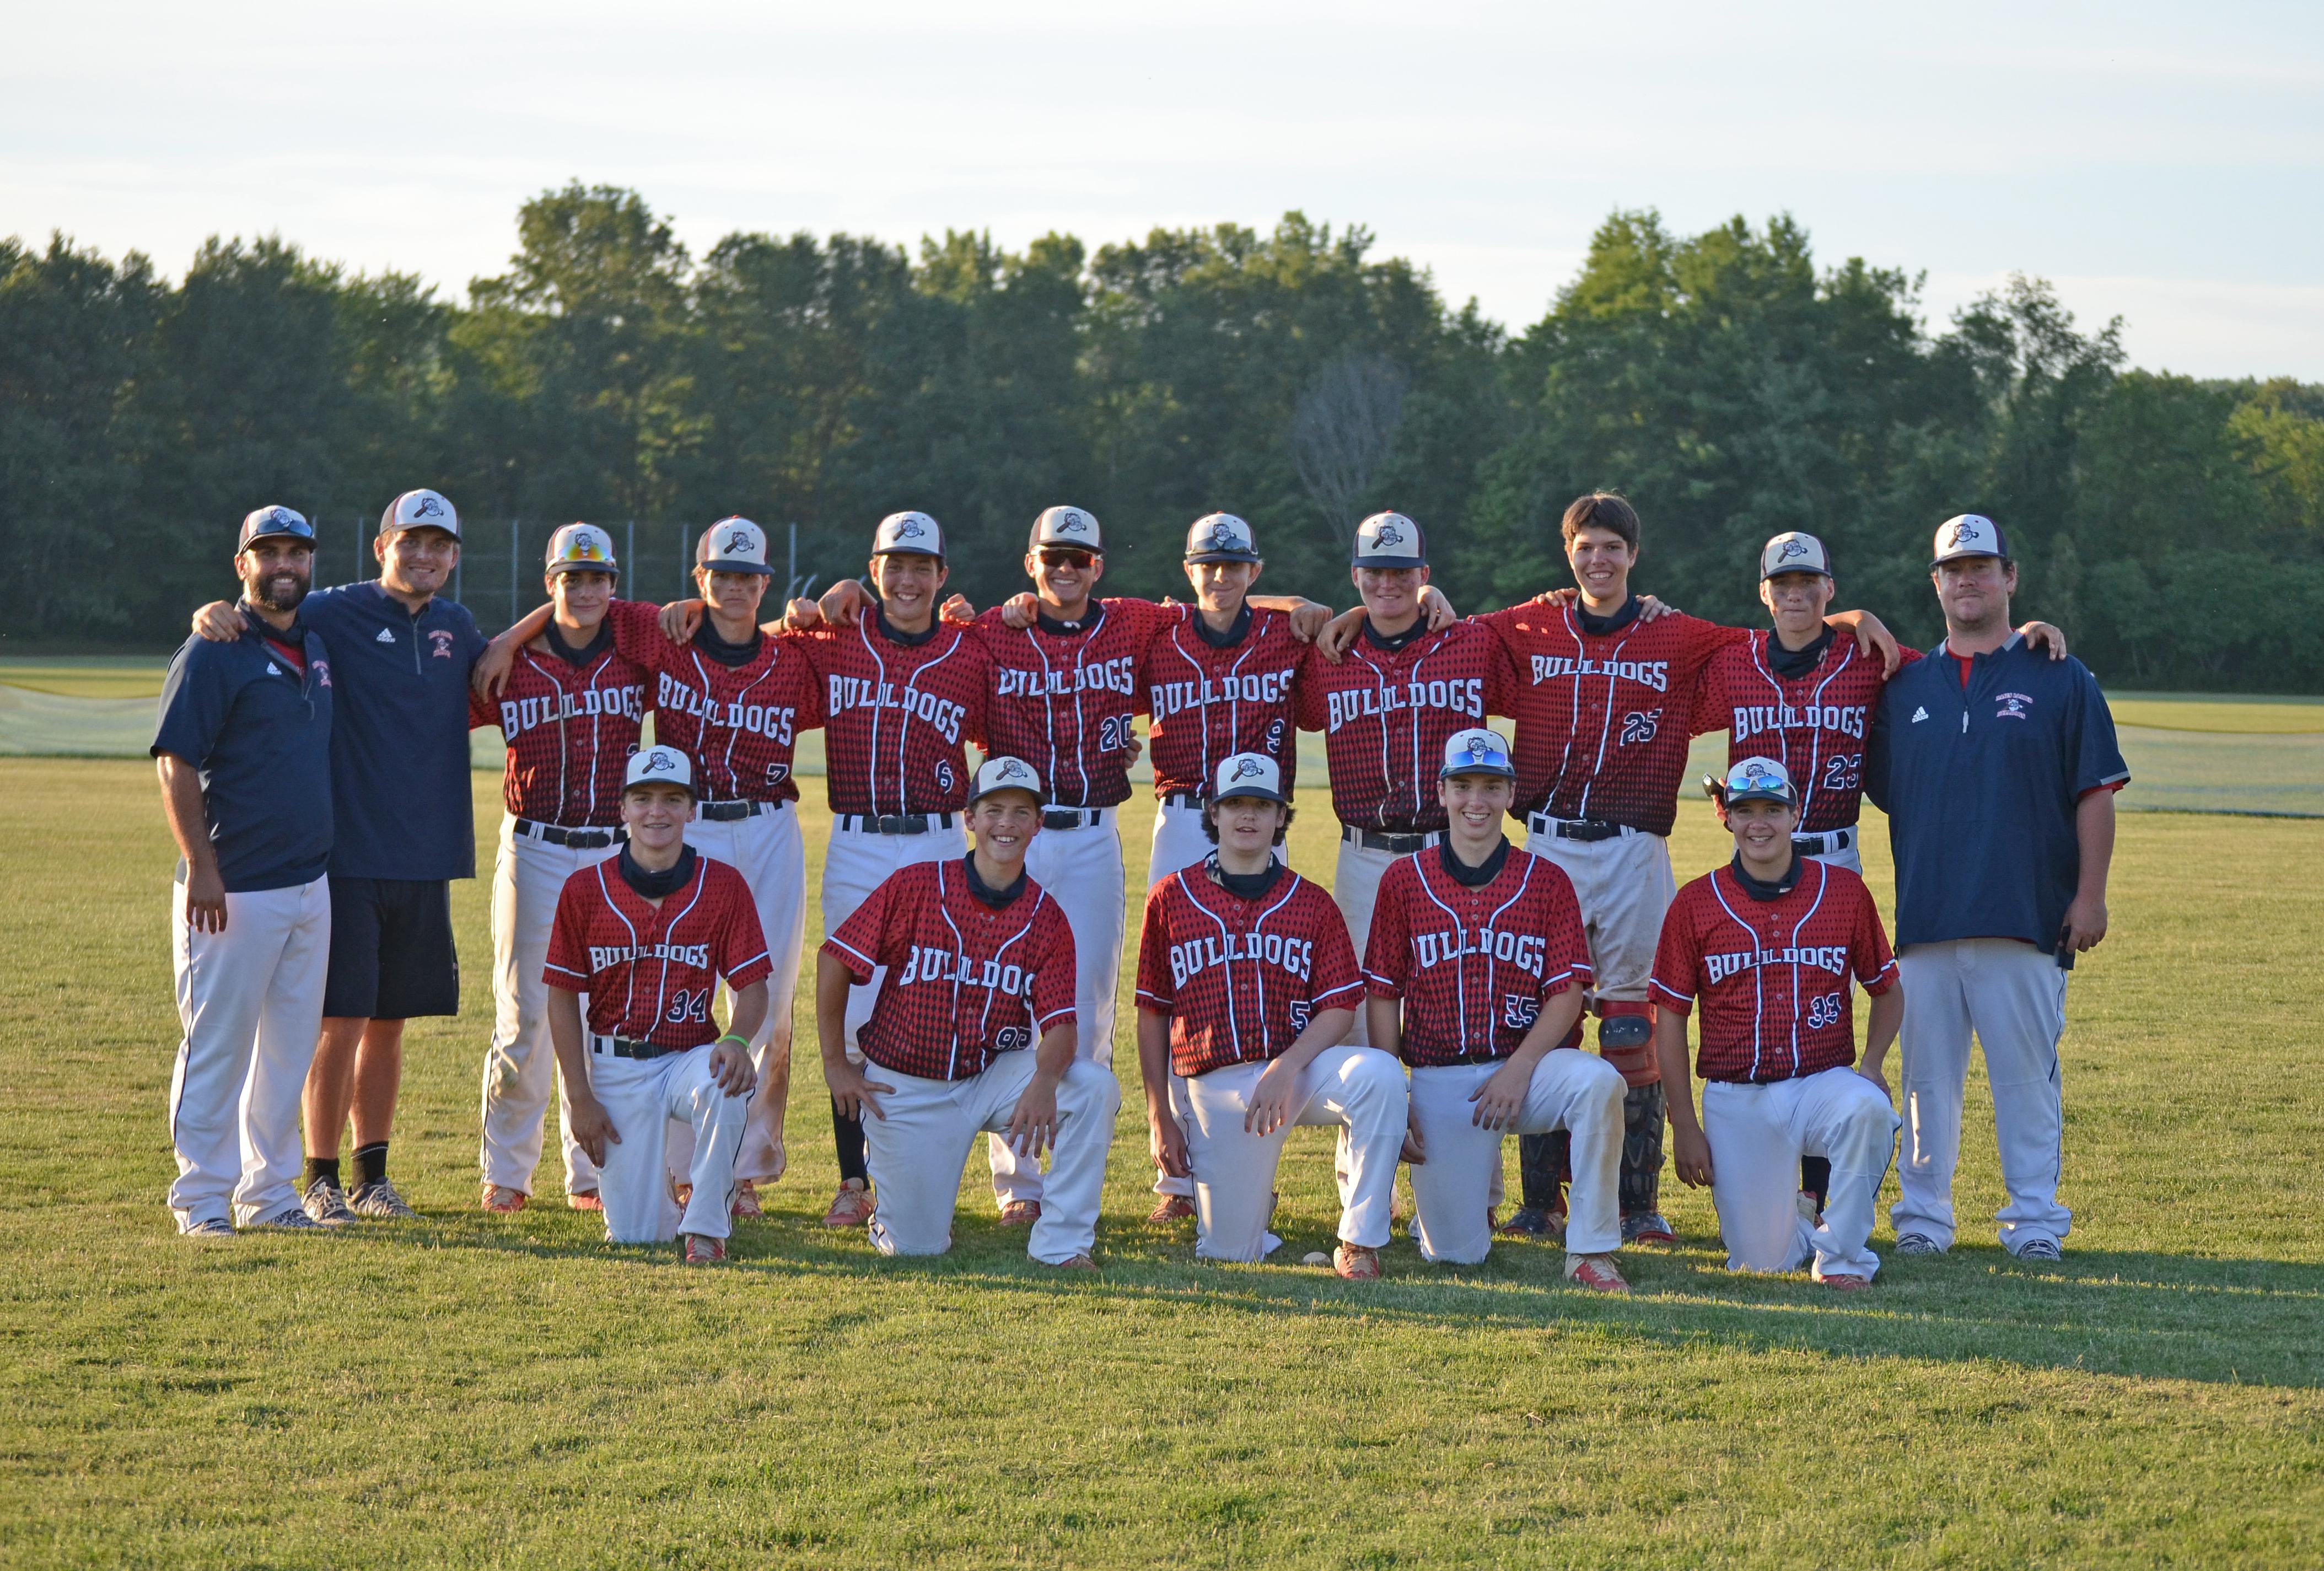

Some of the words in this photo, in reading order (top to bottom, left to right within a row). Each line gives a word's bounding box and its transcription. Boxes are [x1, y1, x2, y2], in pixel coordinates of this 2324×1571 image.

[1531, 655, 1668, 692] BULLDOGS
[500, 684, 645, 742] BULLDOGS
[658, 671, 795, 747] BULLDOGS
[829, 674, 966, 745] BULLDOGS
[1150, 669, 1294, 727] BULLDOGS
[1327, 679, 1482, 734] BULLDOGS
[1100, 713, 1133, 752] 20
[1266, 718, 1285, 754] 9
[1620, 708, 1663, 746] 25
[1734, 706, 1866, 744] BULLDOGS
[766, 763, 789, 786] 7
[935, 759, 954, 794] 6
[1823, 754, 1862, 790] 23
[589, 943, 709, 974] BULLDOGS
[1170, 933, 1312, 991] BULLDOGS
[1410, 928, 1546, 979] ULLDOGS
[1705, 947, 1847, 985] BULLDOGS
[666, 988, 709, 1023] 34
[1289, 1000, 1310, 1036] 5
[1807, 992, 1842, 1029] 33
